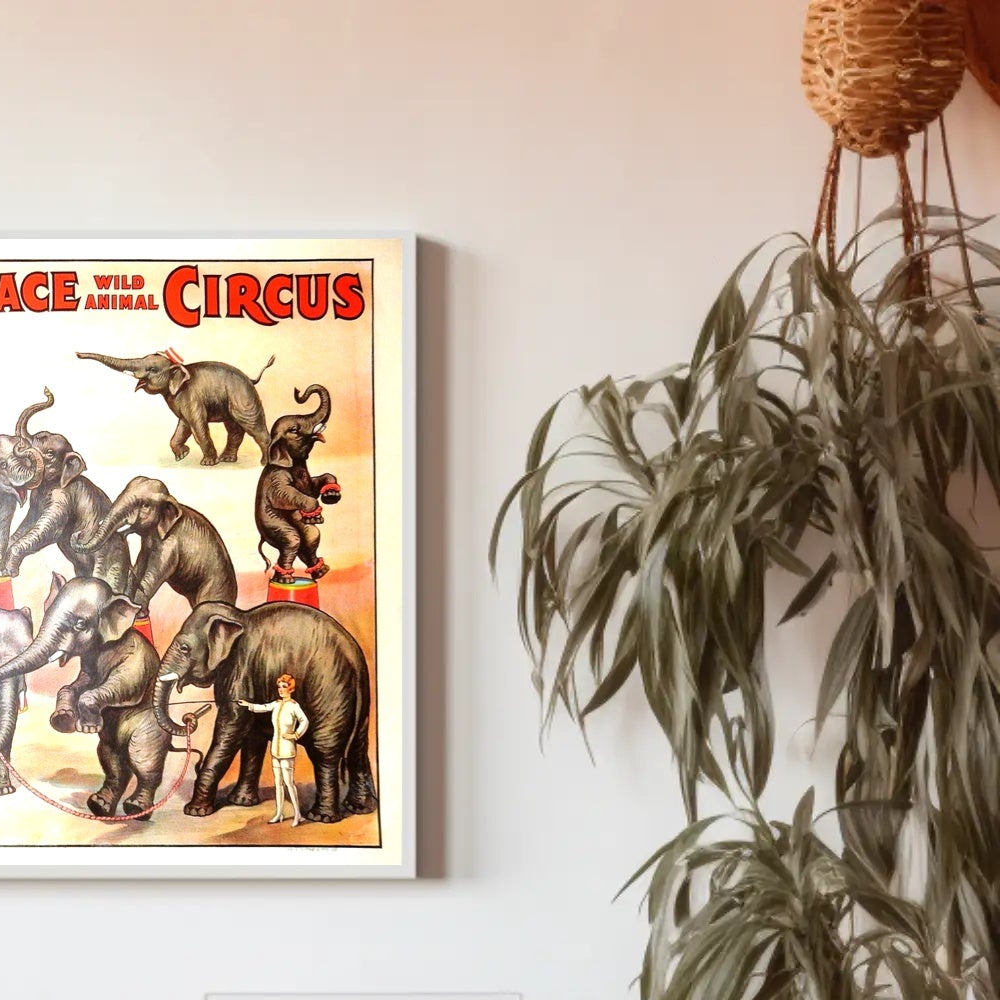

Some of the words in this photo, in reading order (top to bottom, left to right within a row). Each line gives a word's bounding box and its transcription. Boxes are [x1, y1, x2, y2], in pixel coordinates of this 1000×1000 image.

[93, 274, 145, 290] WILD
[84, 293, 159, 310] ANIMAL
[163, 265, 365, 328] CIRCUS
